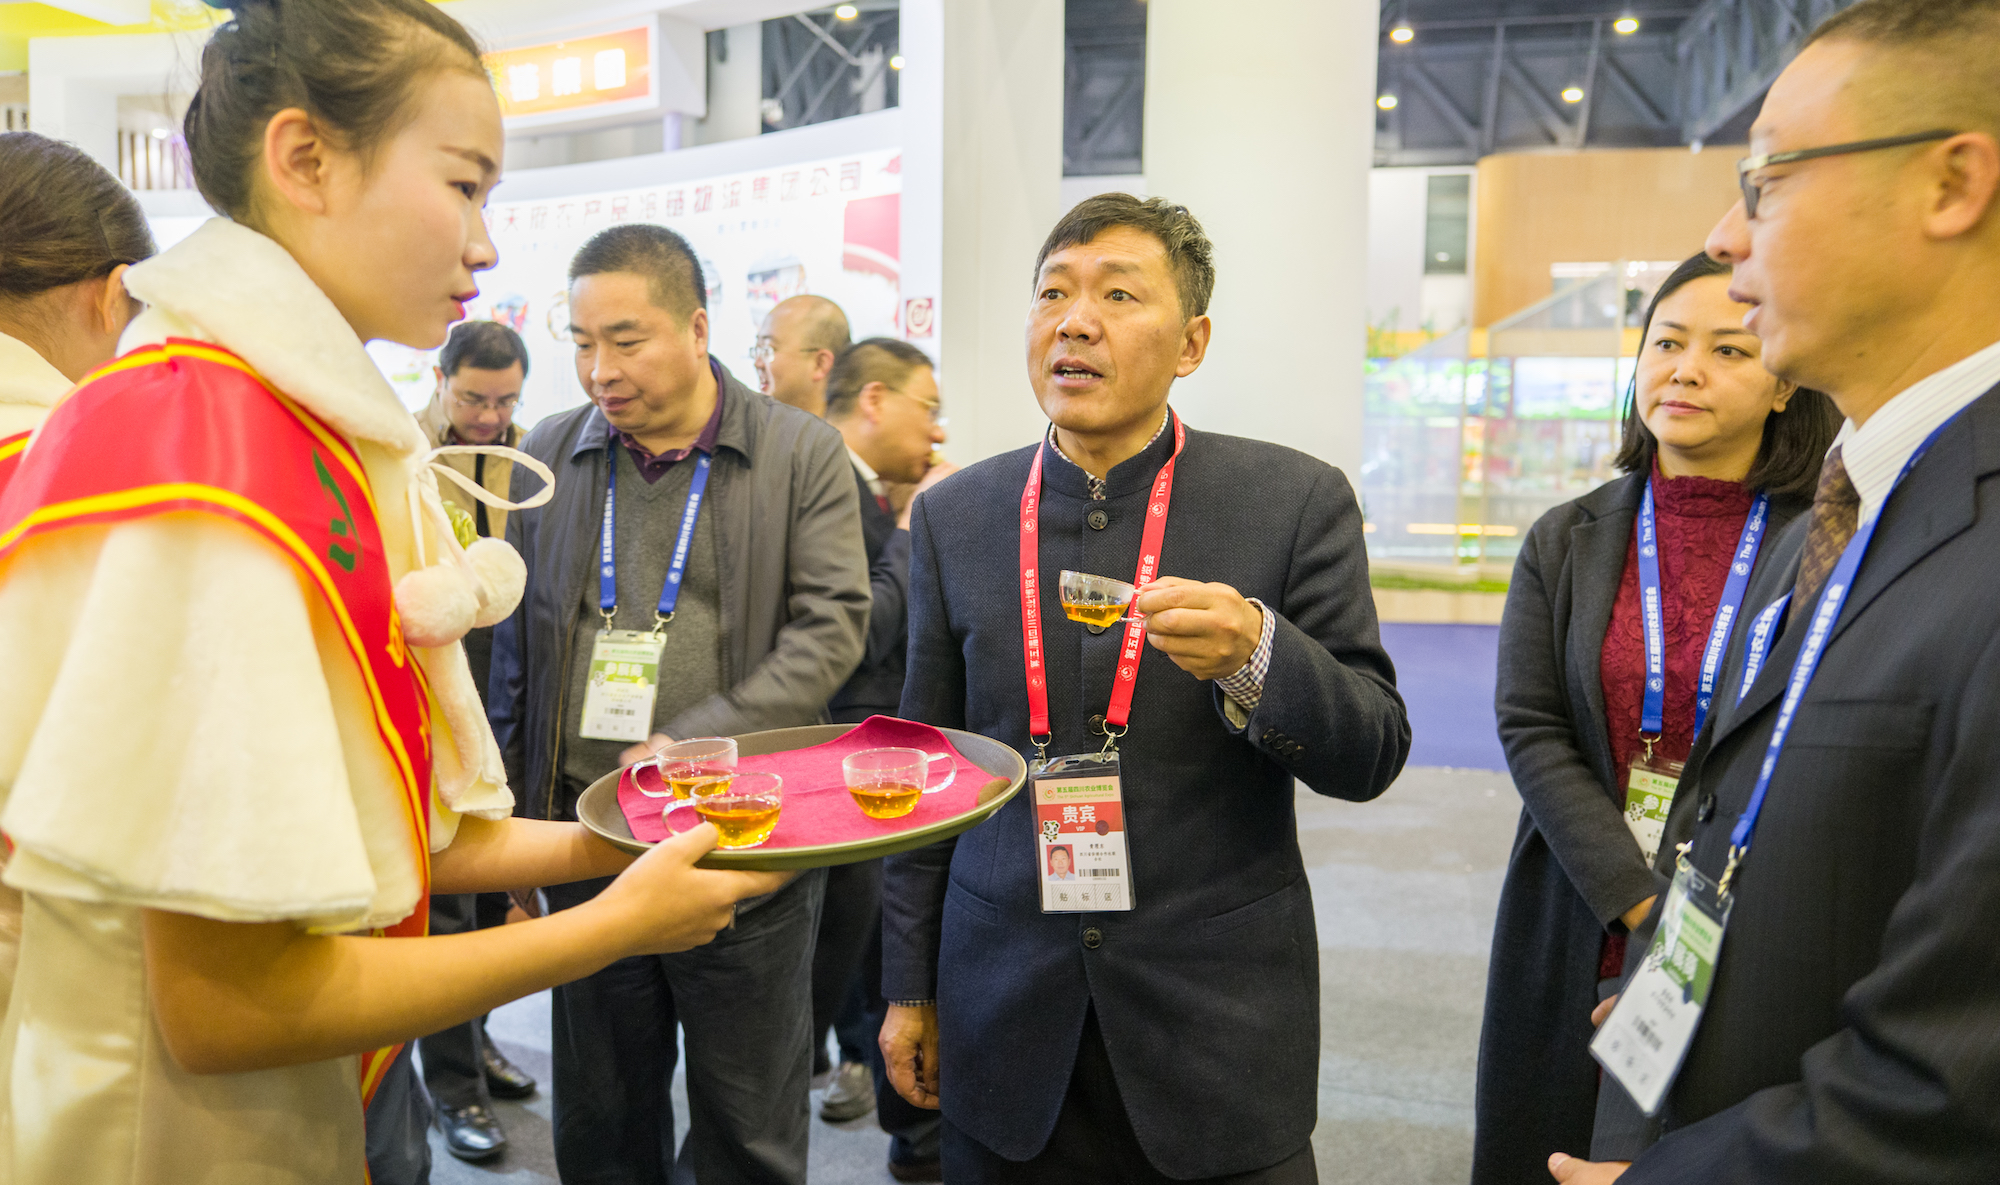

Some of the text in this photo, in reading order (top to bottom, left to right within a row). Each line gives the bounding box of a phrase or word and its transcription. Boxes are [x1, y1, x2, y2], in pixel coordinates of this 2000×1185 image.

[1156, 481, 1167, 498] The
[1026, 498, 1035, 515] The
[1739, 543, 1753, 559] The
[1749, 500, 1767, 532] Sichuan
[1124, 554, 1155, 660] 第五届四博览会
[1701, 604, 1734, 693] 第五届四川农业博览会
[1056, 784, 1114, 794] 第五届四川农业博览会
[1062, 804, 1096, 824] 贵宾
